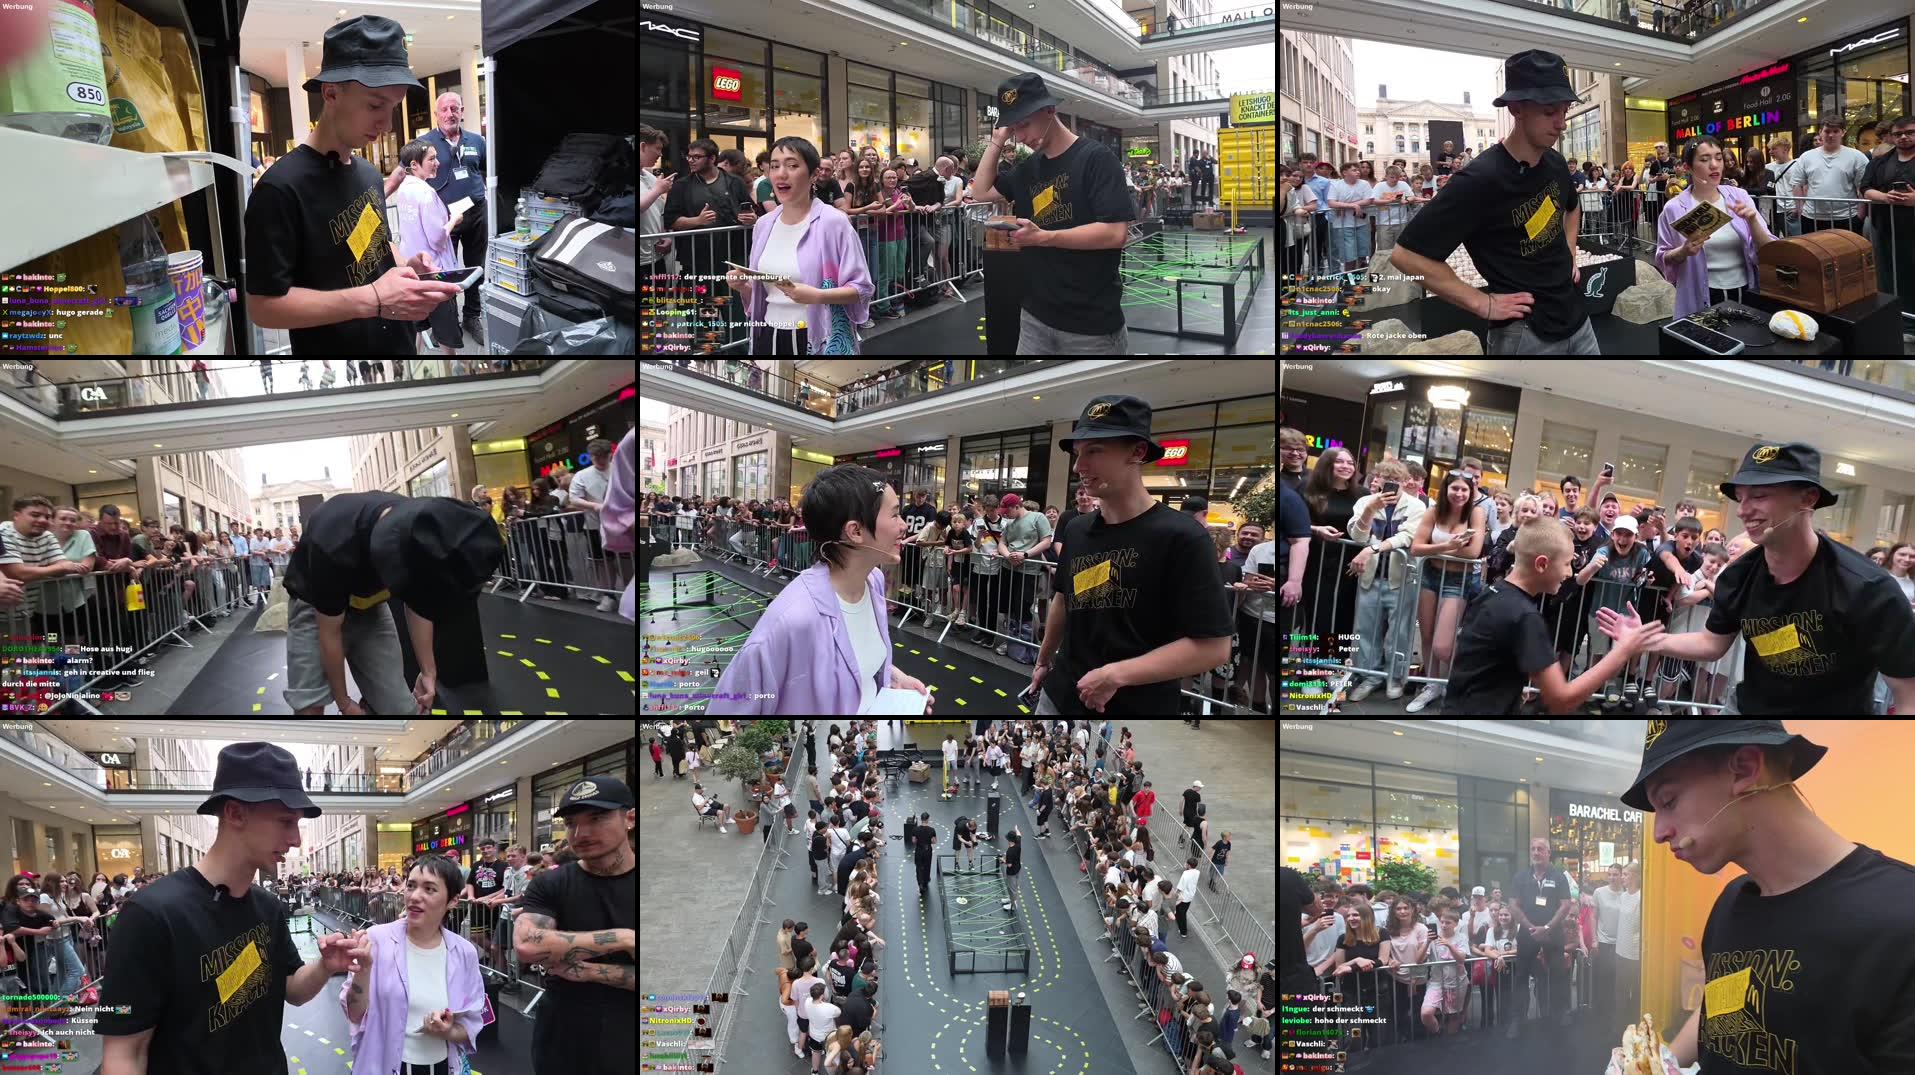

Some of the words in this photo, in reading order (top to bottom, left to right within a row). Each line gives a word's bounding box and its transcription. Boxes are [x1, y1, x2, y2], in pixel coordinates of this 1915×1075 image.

[1222, 10, 1257, 24] MALL
[1830, 28, 1900, 57] MAC
[715, 76, 740, 92] LEGO
[77, 86, 102, 102] 850
[1238, 95, 1271, 107] LETSHUGO
[1240, 102, 1266, 114] KNACKT
[1676, 125, 1703, 140] MALL
[1706, 121, 1724, 134] OF
[1727, 110, 1781, 131] BERLIN
[917, 444, 946, 453] MAC
[1163, 446, 1188, 460] EGO
[484, 789, 513, 804] MAC
[1569, 803, 1622, 821] BARACHEL
[416, 842, 429, 852] MALL
[430, 840, 439, 849] OF
[440, 834, 465, 848] BERLIN
